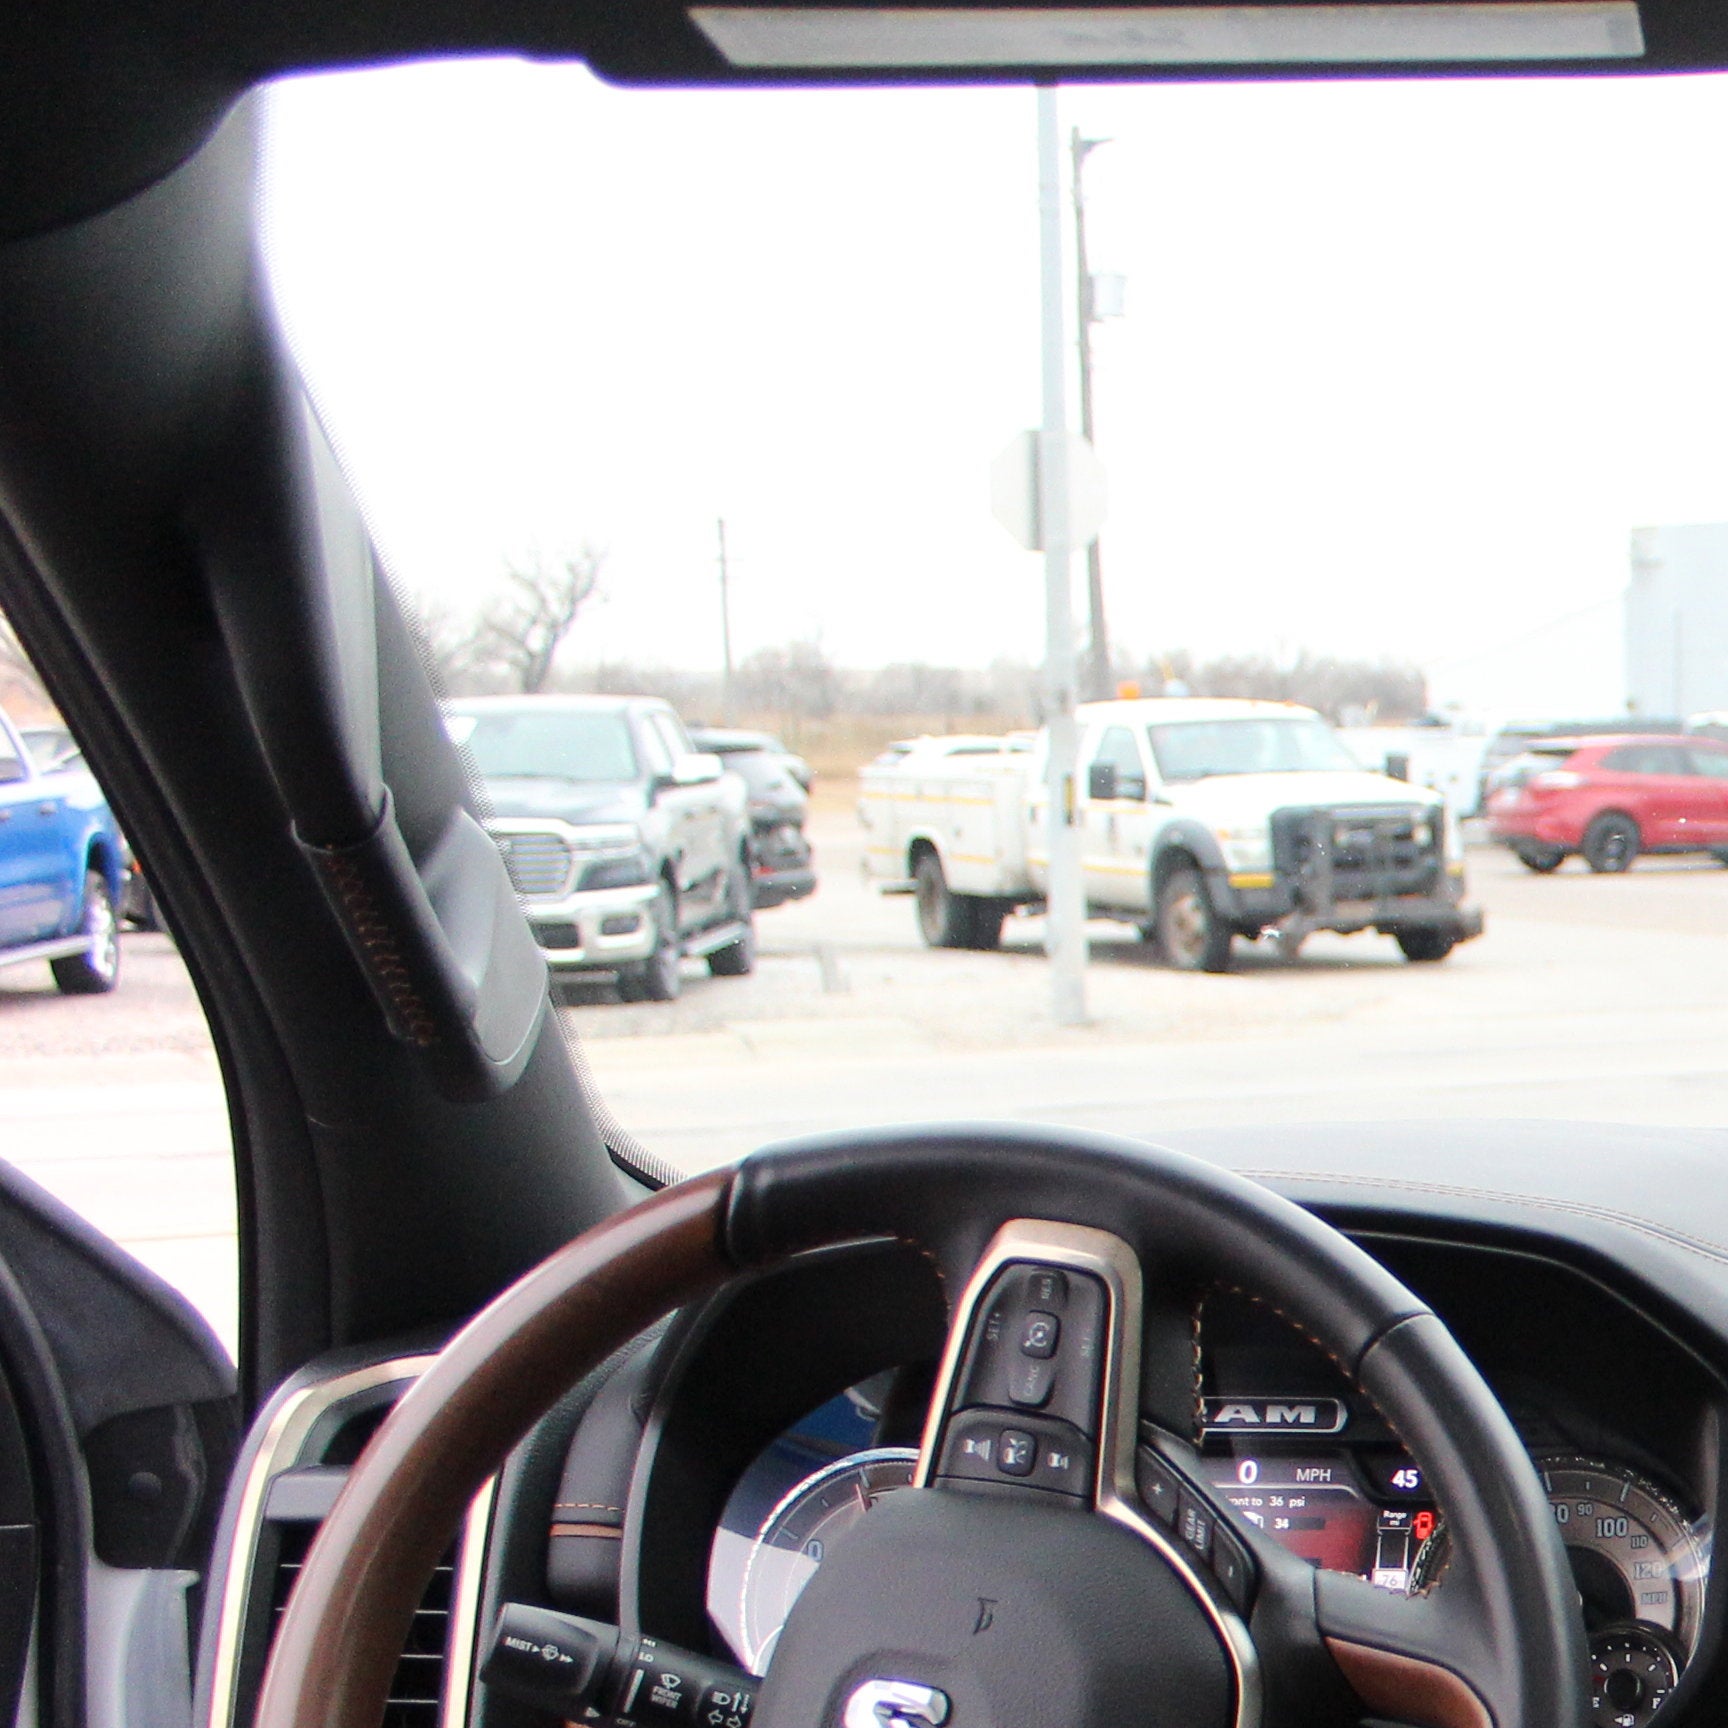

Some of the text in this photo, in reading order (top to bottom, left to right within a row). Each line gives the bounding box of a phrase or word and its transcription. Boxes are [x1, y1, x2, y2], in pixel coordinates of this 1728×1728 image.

[1203, 1404, 1316, 1424] AM
[1238, 1460, 1331, 1484] 0 MPH
[1391, 1470, 1419, 1488] 45
[1269, 1496, 1283, 1506] 36
[1289, 1496, 1306, 1509] psi
[1577, 1503, 1593, 1516] 90
[1274, 1519, 1290, 1529] 34
[1596, 1517, 1628, 1538] 100
[1631, 1536, 1649, 1548] 110
[1633, 1562, 1663, 1580] 120
[504, 1636, 532, 1652] MIST
[638, 1651, 655, 1663] LO
